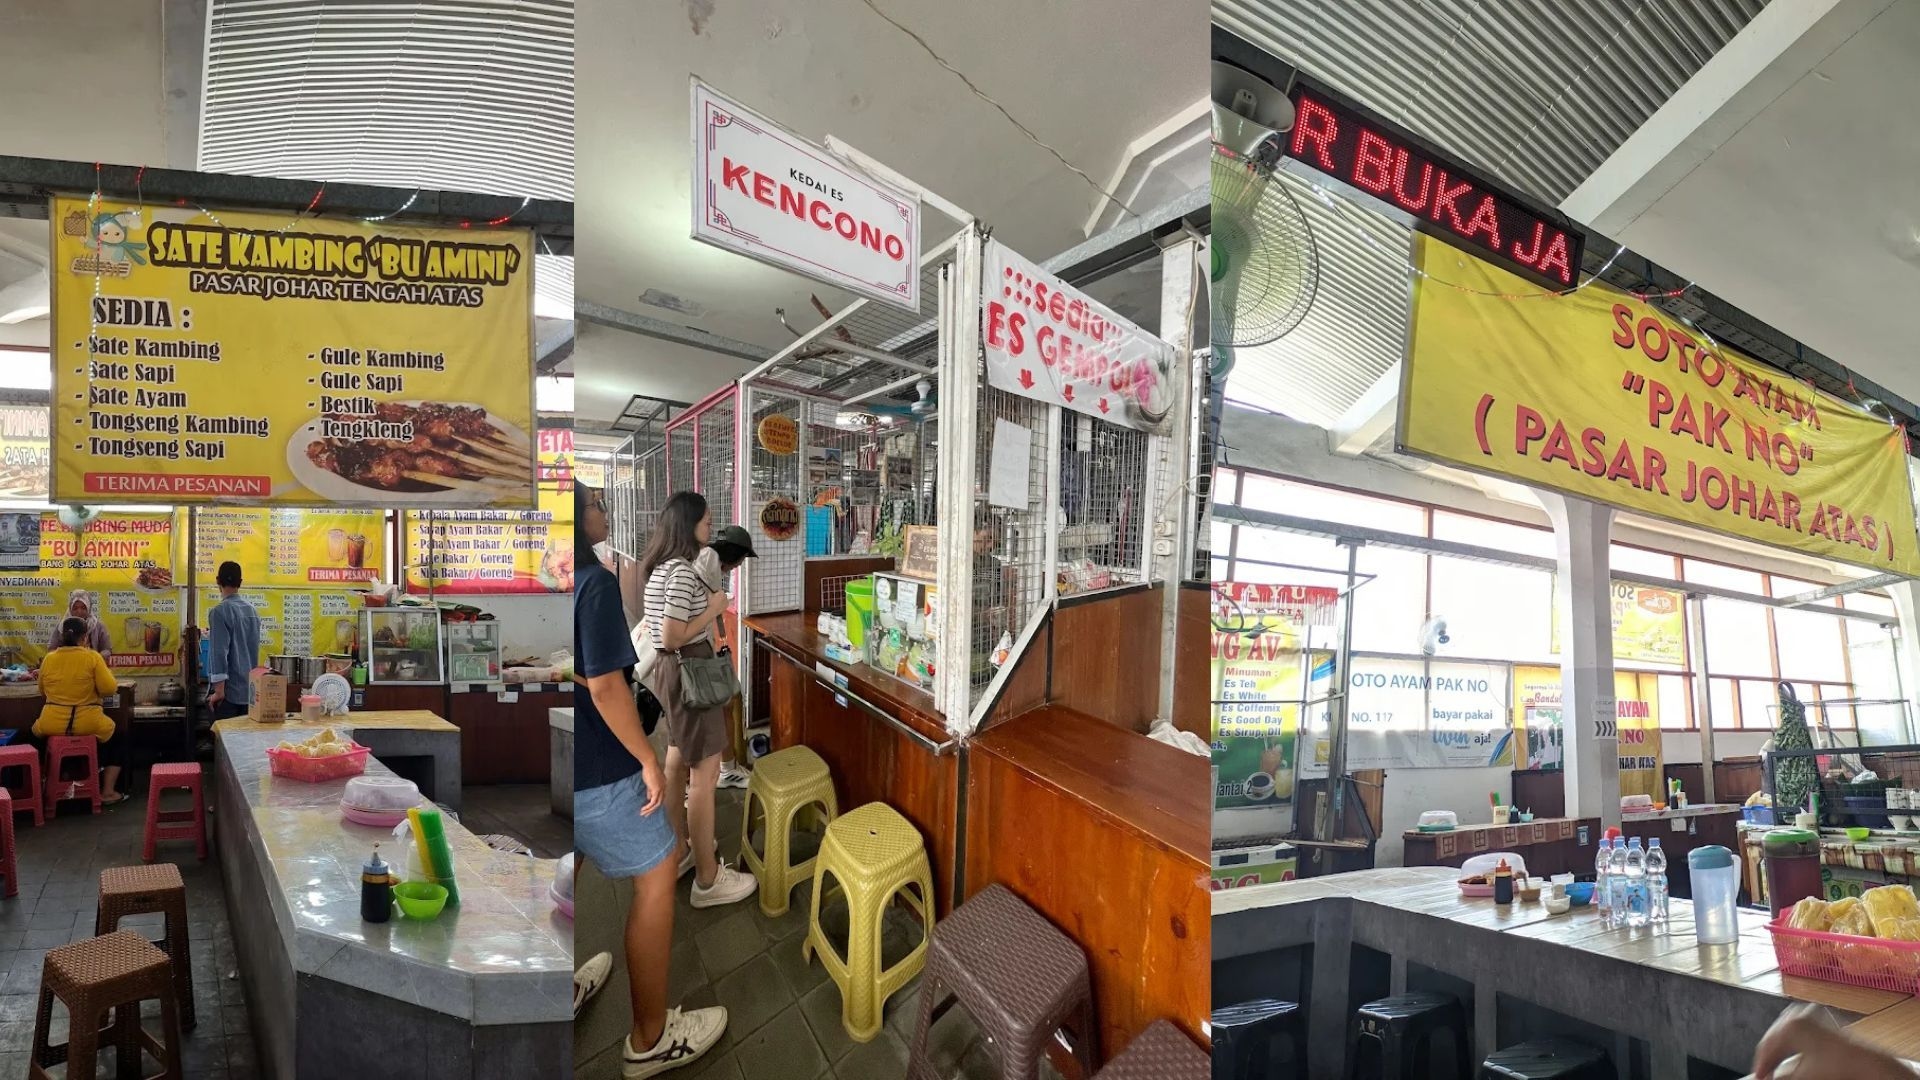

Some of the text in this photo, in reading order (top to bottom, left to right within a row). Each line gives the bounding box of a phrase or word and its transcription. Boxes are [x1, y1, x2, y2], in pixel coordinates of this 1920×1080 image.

[790, 167, 844, 202] KEDAI ES
[722, 156, 905, 261] KENCONO
[1352, 127, 1501, 250] BUKA
[1512, 220, 1571, 283] JA
[152, 225, 223, 265] SATE
[228, 232, 365, 275] KAMBING
[426, 246, 517, 282] AMINI"
[193, 273, 482, 306] PASAR JOHAR TENGAH ATAS
[93, 297, 173, 328] SEDIA
[987, 301, 1026, 355] ES
[89, 335, 221, 361] Sate Kambing
[321, 347, 445, 371] Gule Kambing
[1611, 303, 1823, 431] SOTO AYAM
[89, 361, 175, 384] Sate Sapi
[321, 371, 403, 392] Gule Sapi
[89, 386, 187, 408] Sate Ayam
[321, 396, 375, 414] Bestik
[89, 411, 269, 437] Tongseng Kambing
[321, 419, 414, 441] Tengkleng
[89, 437, 225, 460] Tongseng Sapi
[96, 475, 261, 493] TERIMA PESANAN
[1515, 403, 1671, 497] PASAR
[1680, 460, 1803, 533] JOHAR
[1808, 500, 1880, 552] ATAS
[454, 510, 478, 522] Ayam
[480, 511, 508, 521] Bakar
[519, 511, 553, 522] Goreng
[131, 520, 172, 533] MUDA
[475, 525, 503, 535] Bakar
[514, 525, 548, 536] Goreng
[473, 539, 501, 550] Bakar
[512, 538, 546, 550] Goreng
[69, 560, 97, 569] PASAR
[101, 560, 129, 569] JOHAR
[442, 554, 469, 564] Bakar
[480, 553, 514, 565] Goreng
[310, 569, 340, 580] TERIMA
[441, 568, 469, 578] Bakar
[479, 567, 513, 579] Goreng
[1225, 667, 1272, 678] Minuman
[1224, 679, 1256, 688] Es Teh
[1349, 672, 1489, 693] OTO AYAM PAK NO
[1223, 691, 1267, 701] Es White
[1221, 702, 1234, 713] Es
[1432, 707, 1493, 722] bayar pakai
[1617, 700, 1650, 718] AYAM
[1220, 715, 1283, 727] Es Good Day
[1351, 711, 1372, 723] NO.
[1219, 728, 1231, 737] Es
[1473, 732, 1492, 746] aja!
[1624, 729, 1645, 744] NO
[1618, 757, 1636, 770] HAR
